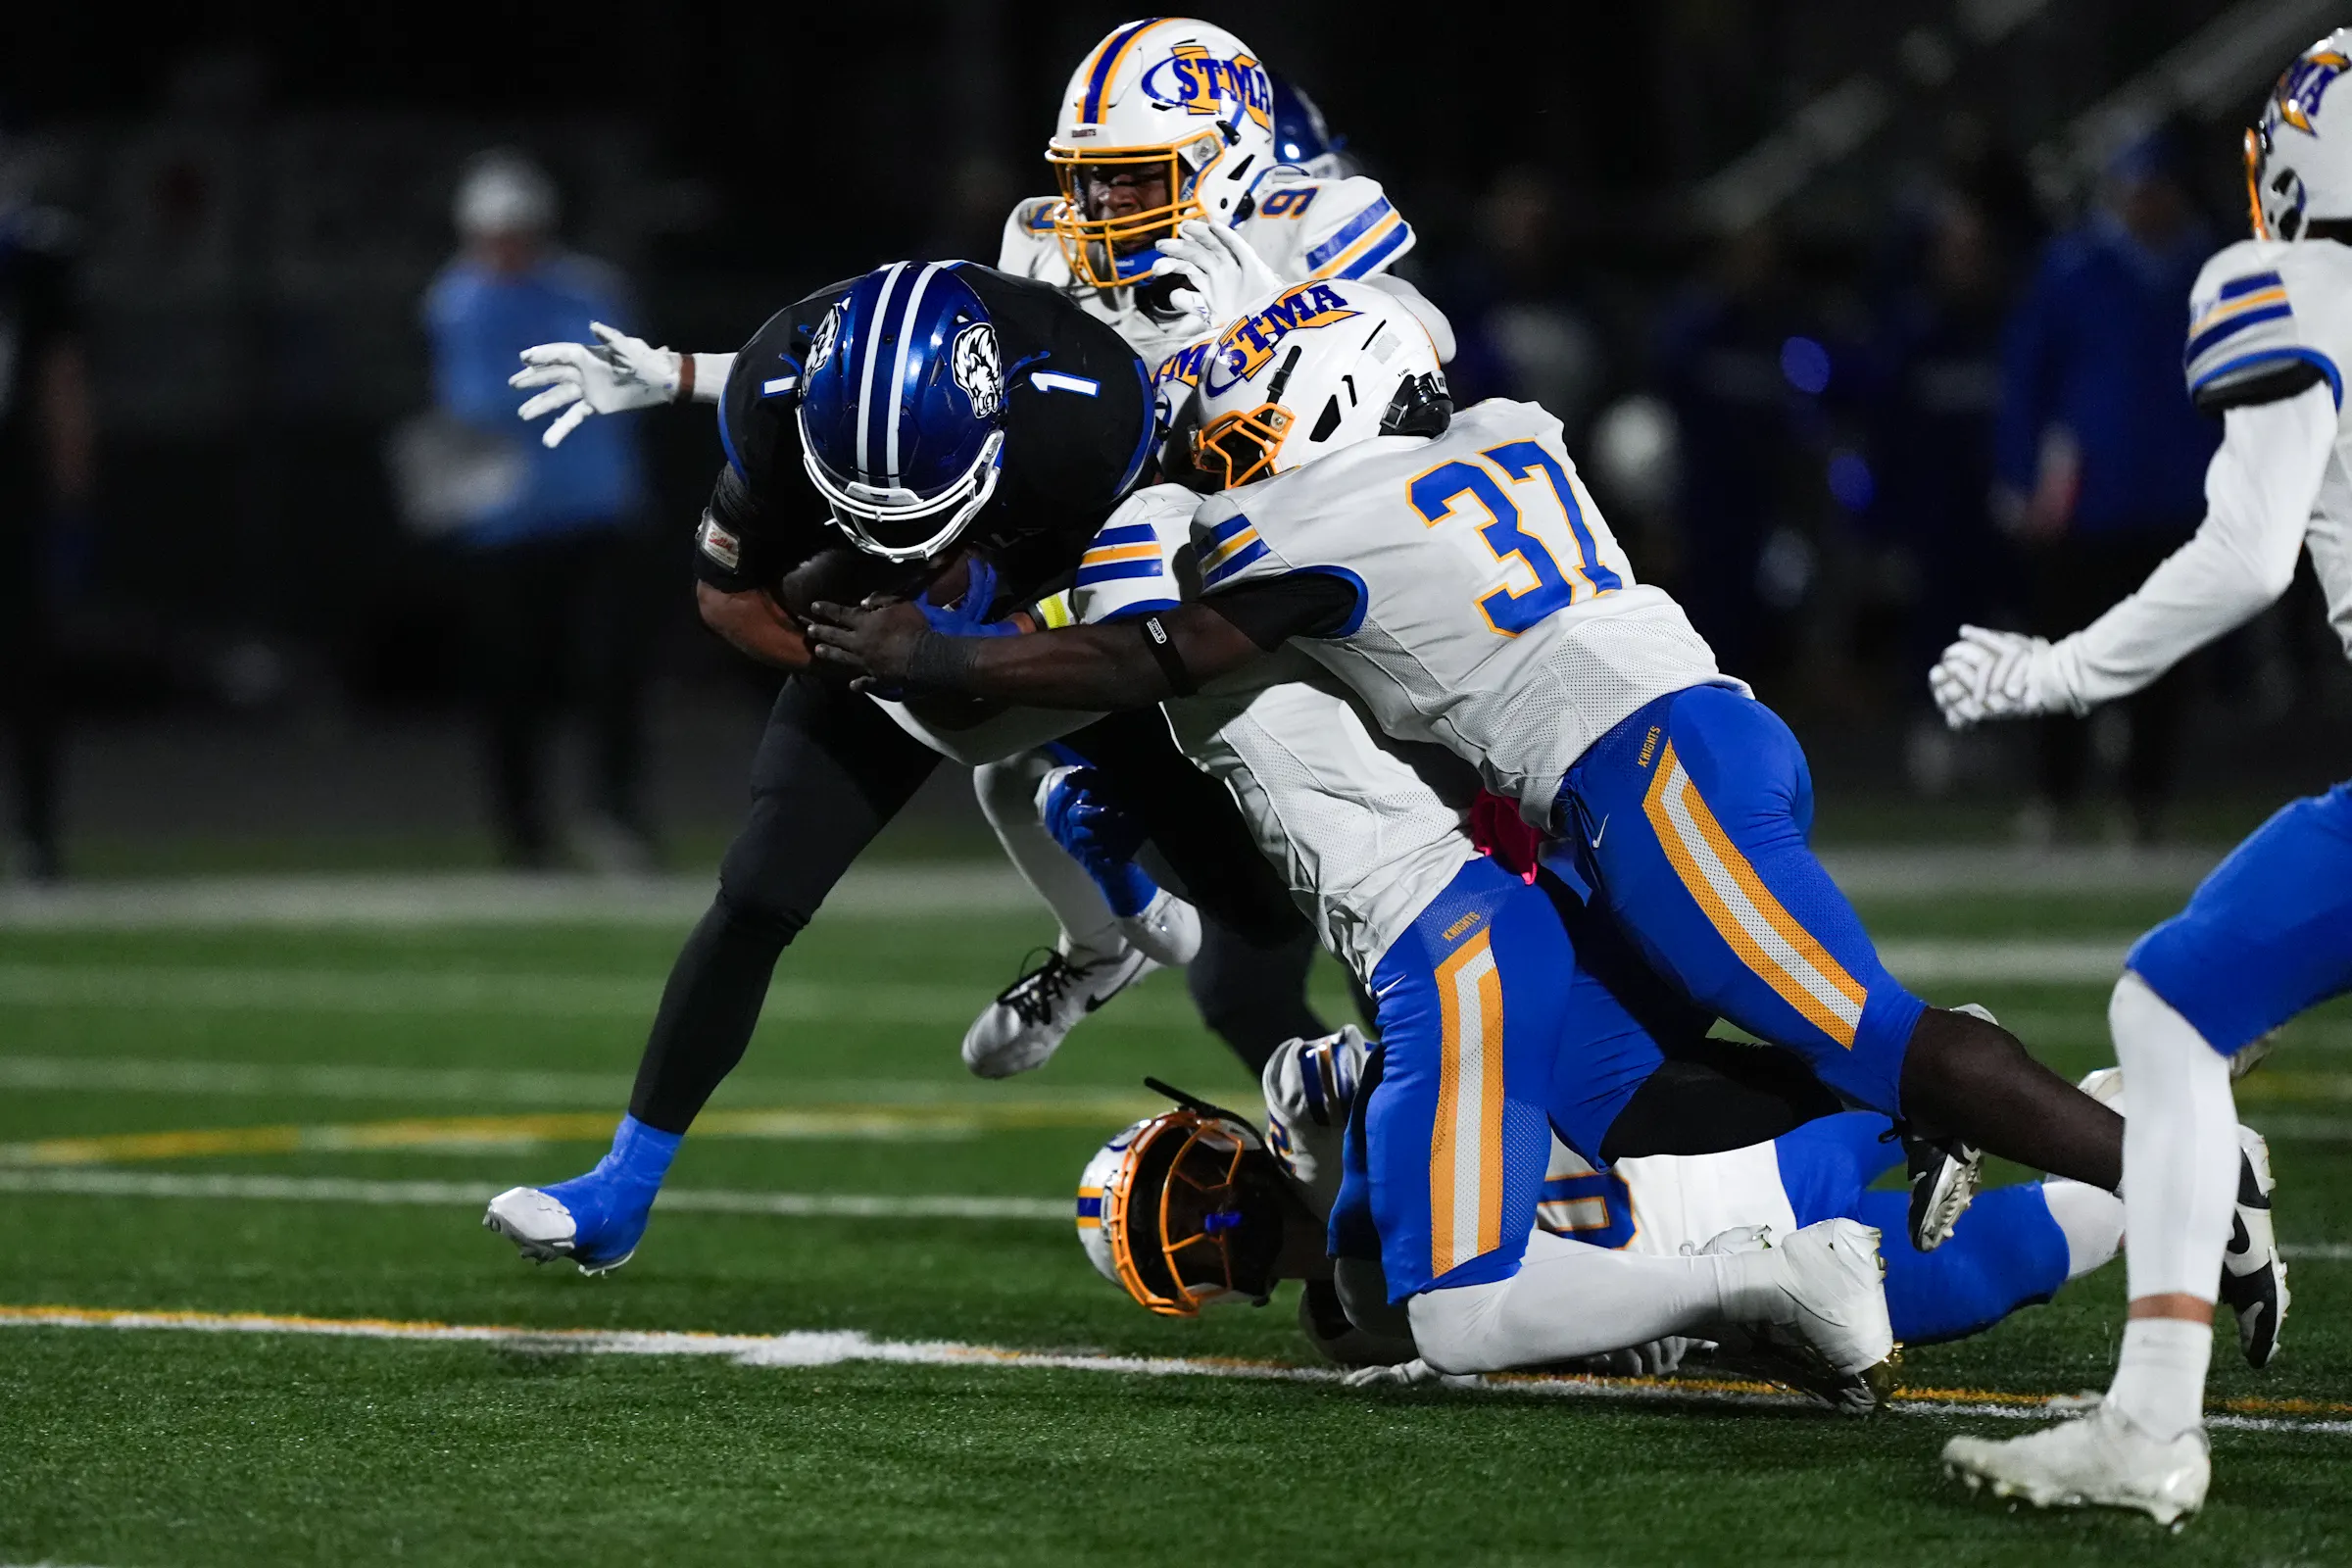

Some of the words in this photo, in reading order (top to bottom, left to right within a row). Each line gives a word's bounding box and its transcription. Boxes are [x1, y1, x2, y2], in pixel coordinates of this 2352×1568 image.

[1172, 57, 1272, 117] STMA
[1258, 185, 1321, 220] 9
[1218, 283, 1349, 379] STMA
[1029, 368, 1102, 398] 1
[1405, 437, 1623, 639] 37
[1637, 725, 1662, 768] KNIGHTS
[1441, 910, 1482, 942] KNIGHTS
